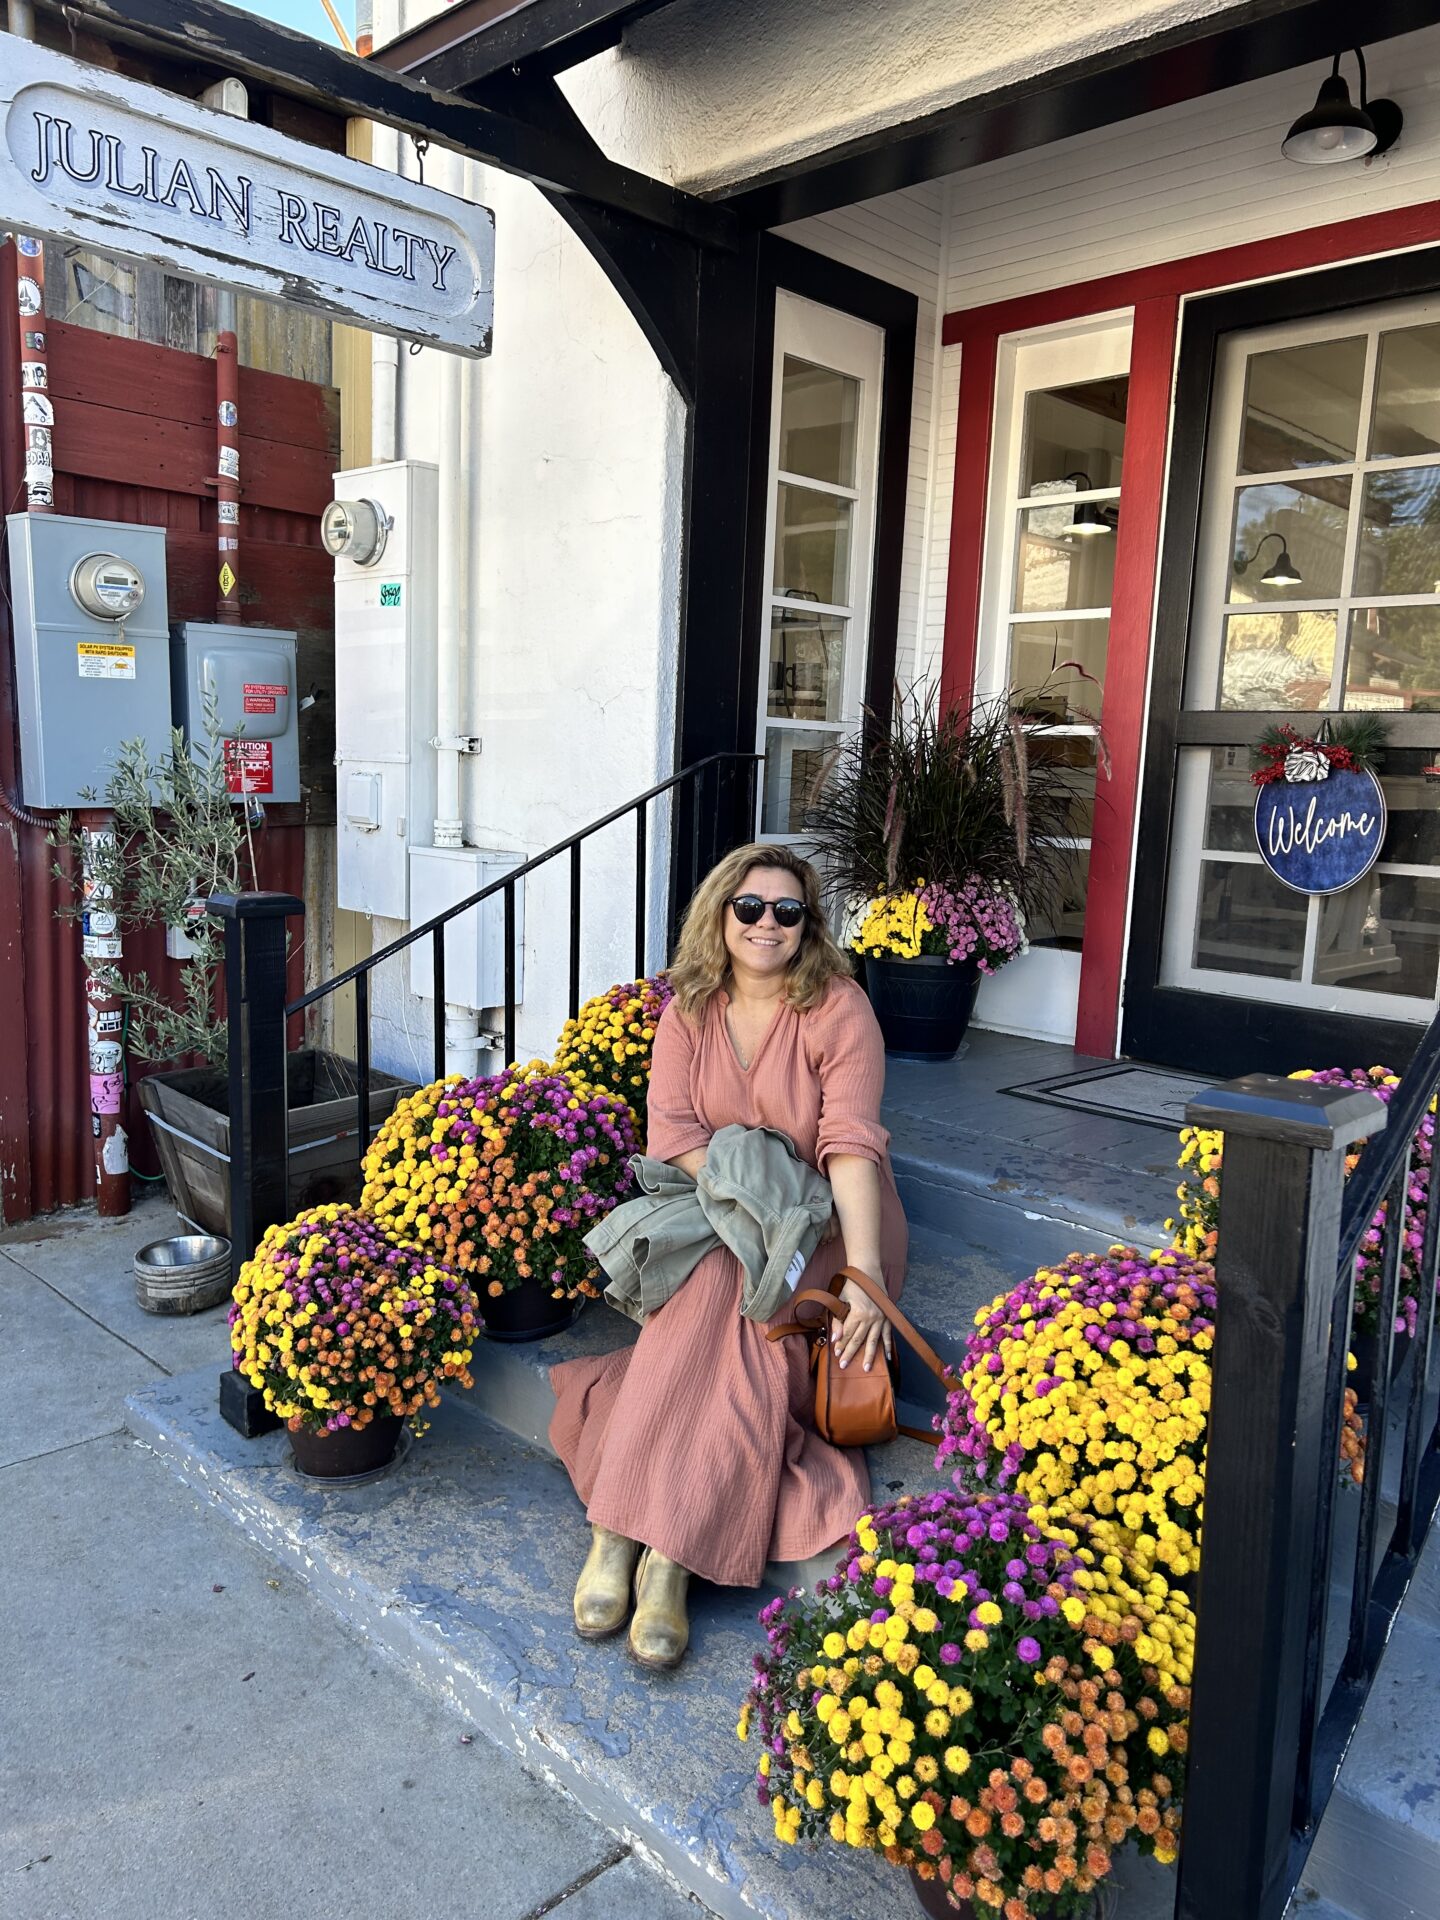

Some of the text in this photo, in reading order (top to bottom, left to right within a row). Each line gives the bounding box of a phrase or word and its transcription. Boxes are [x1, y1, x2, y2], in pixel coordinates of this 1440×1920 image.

[32, 112, 455, 291] JULIAN REALTY
[229, 741, 267, 751] CAUTION
[1269, 796, 1375, 856] Welcome
